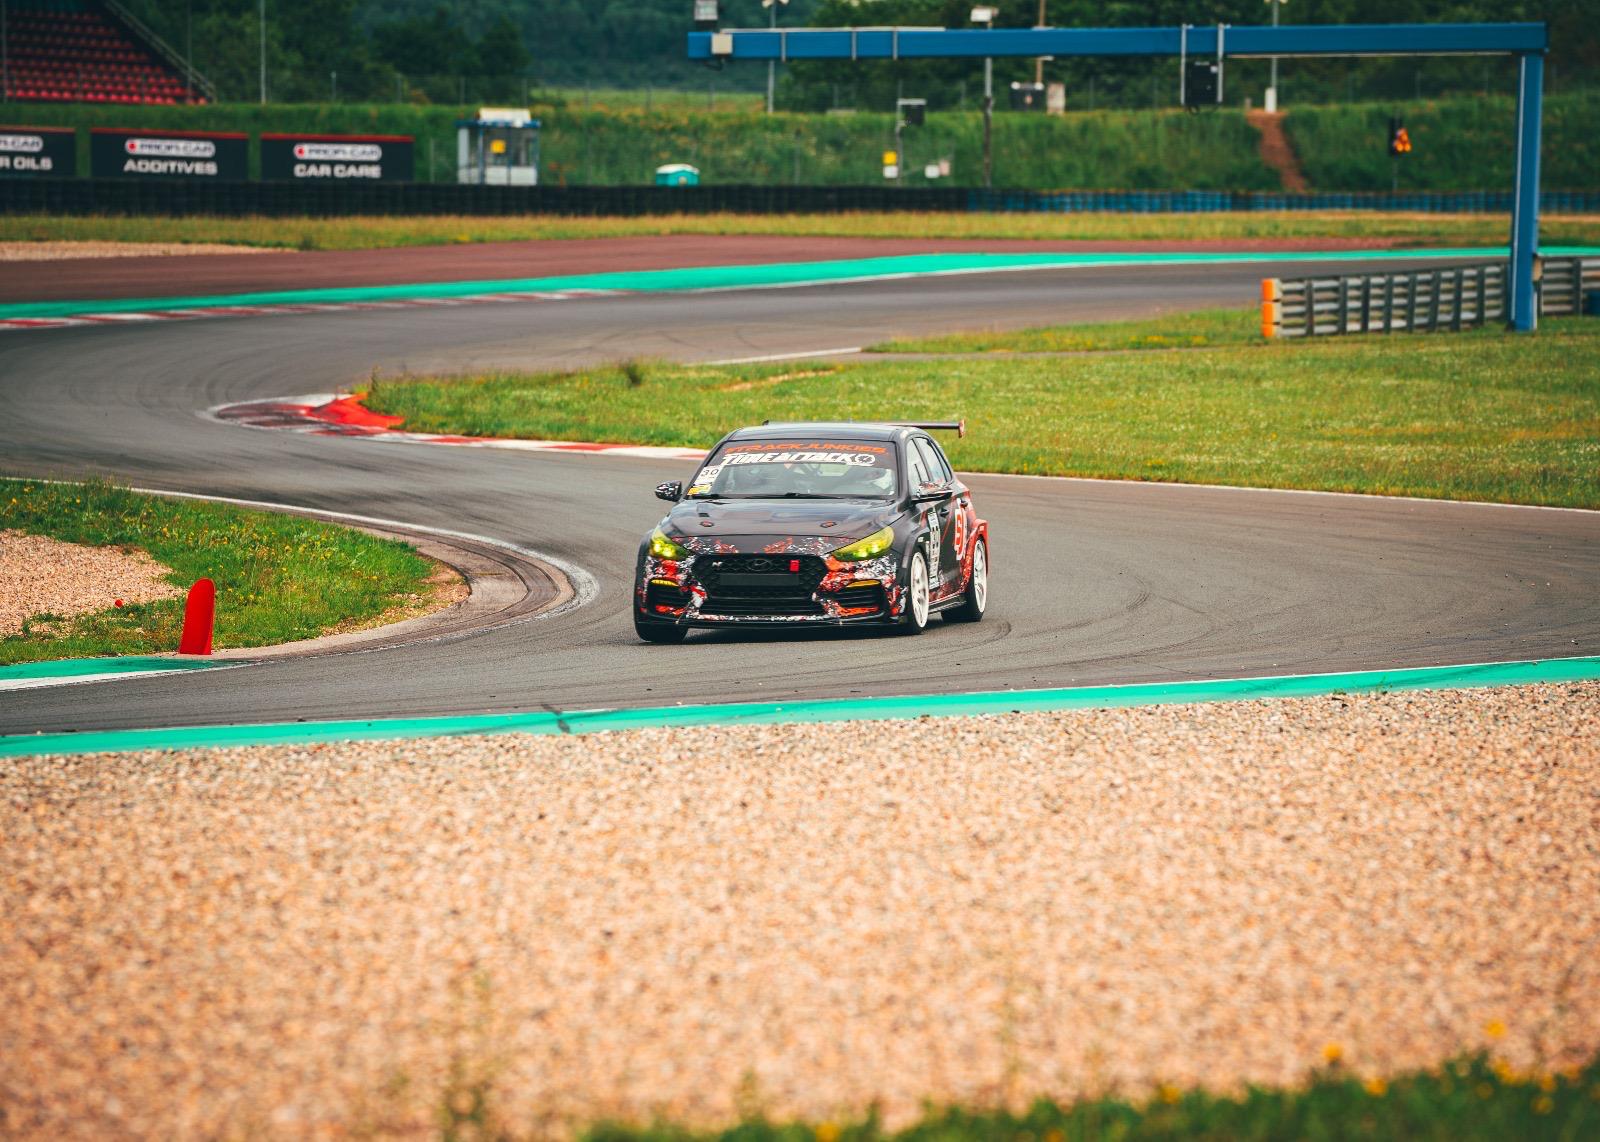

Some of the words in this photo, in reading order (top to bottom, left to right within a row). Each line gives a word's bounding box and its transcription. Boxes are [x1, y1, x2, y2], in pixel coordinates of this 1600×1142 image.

[13, 156, 53, 170] OILS
[123, 158, 218, 176] ADDITIVES
[293, 163, 332, 178] CAR
[333, 164, 382, 179] CARE
